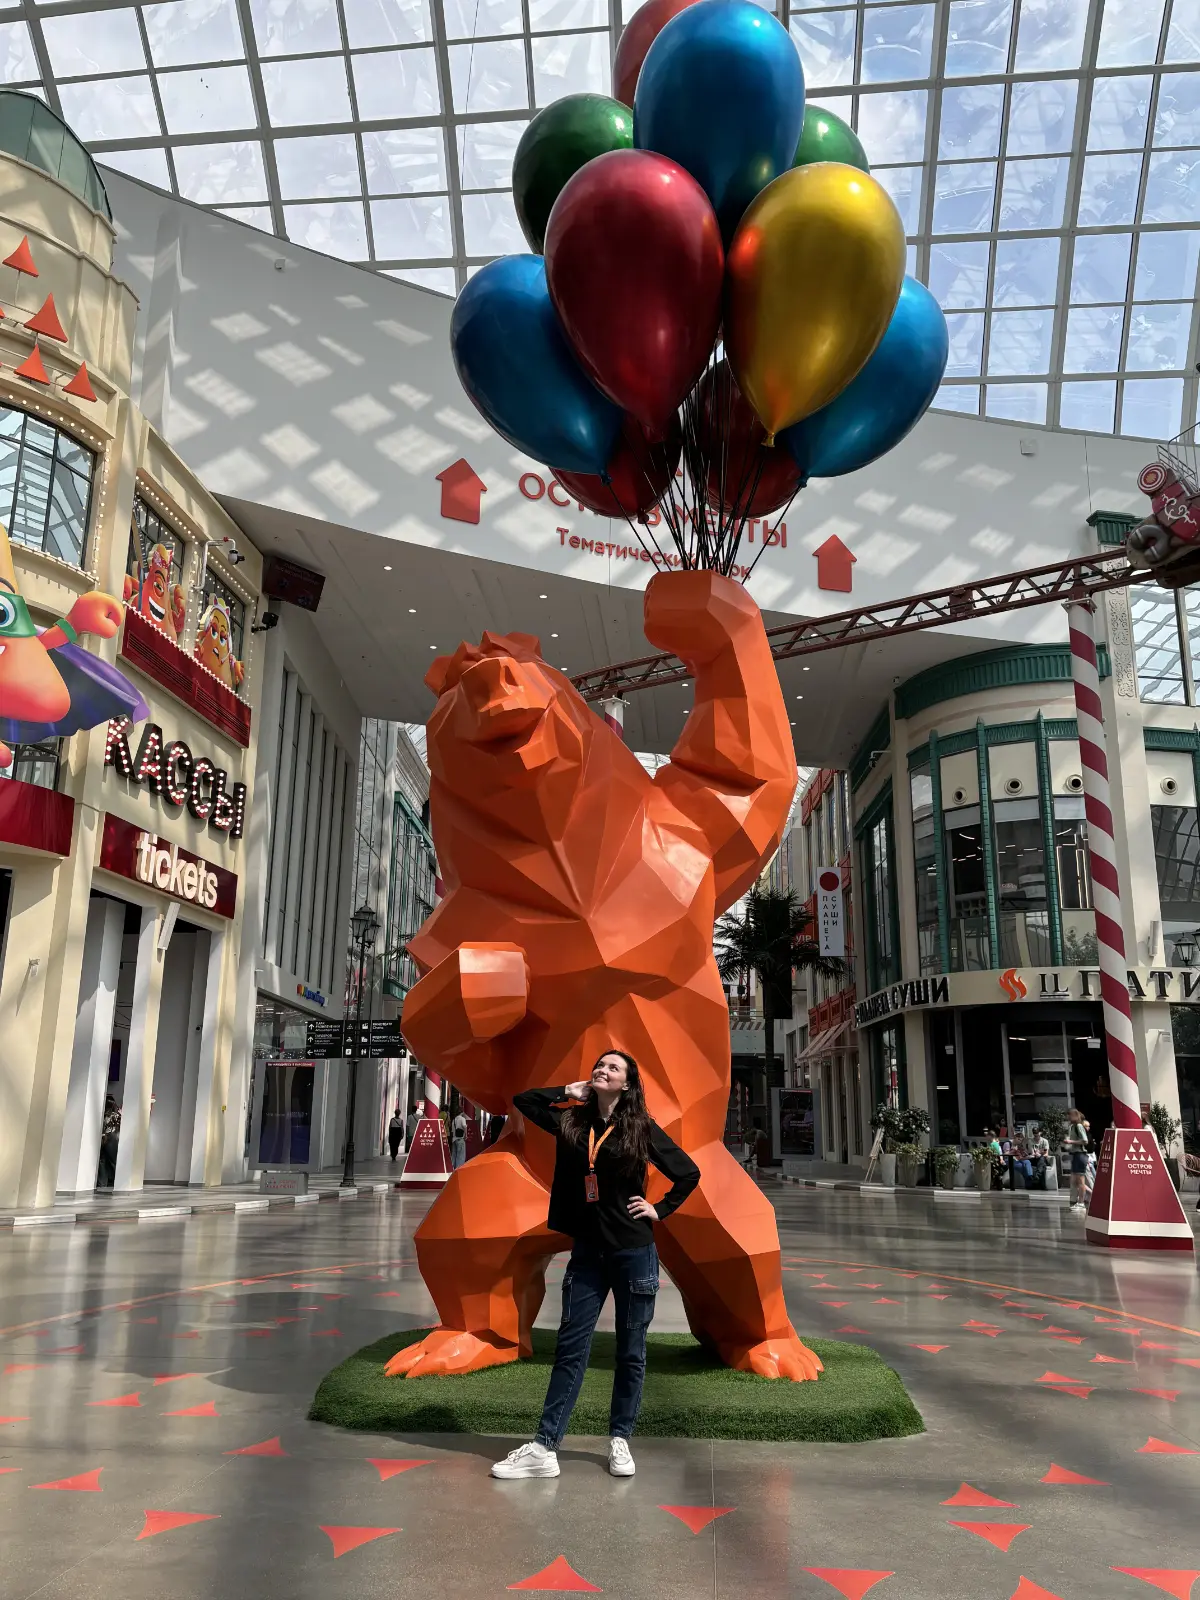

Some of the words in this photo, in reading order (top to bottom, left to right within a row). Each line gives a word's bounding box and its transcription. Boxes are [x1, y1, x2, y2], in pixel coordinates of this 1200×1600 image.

[104, 714, 247, 839] КАССЫ
[136, 831, 219, 908] tickets
[822, 895, 831, 950] ПЛАНЕТА
[831, 895, 839, 926] СУШИ
[891, 976, 950, 1010] СУШИ
